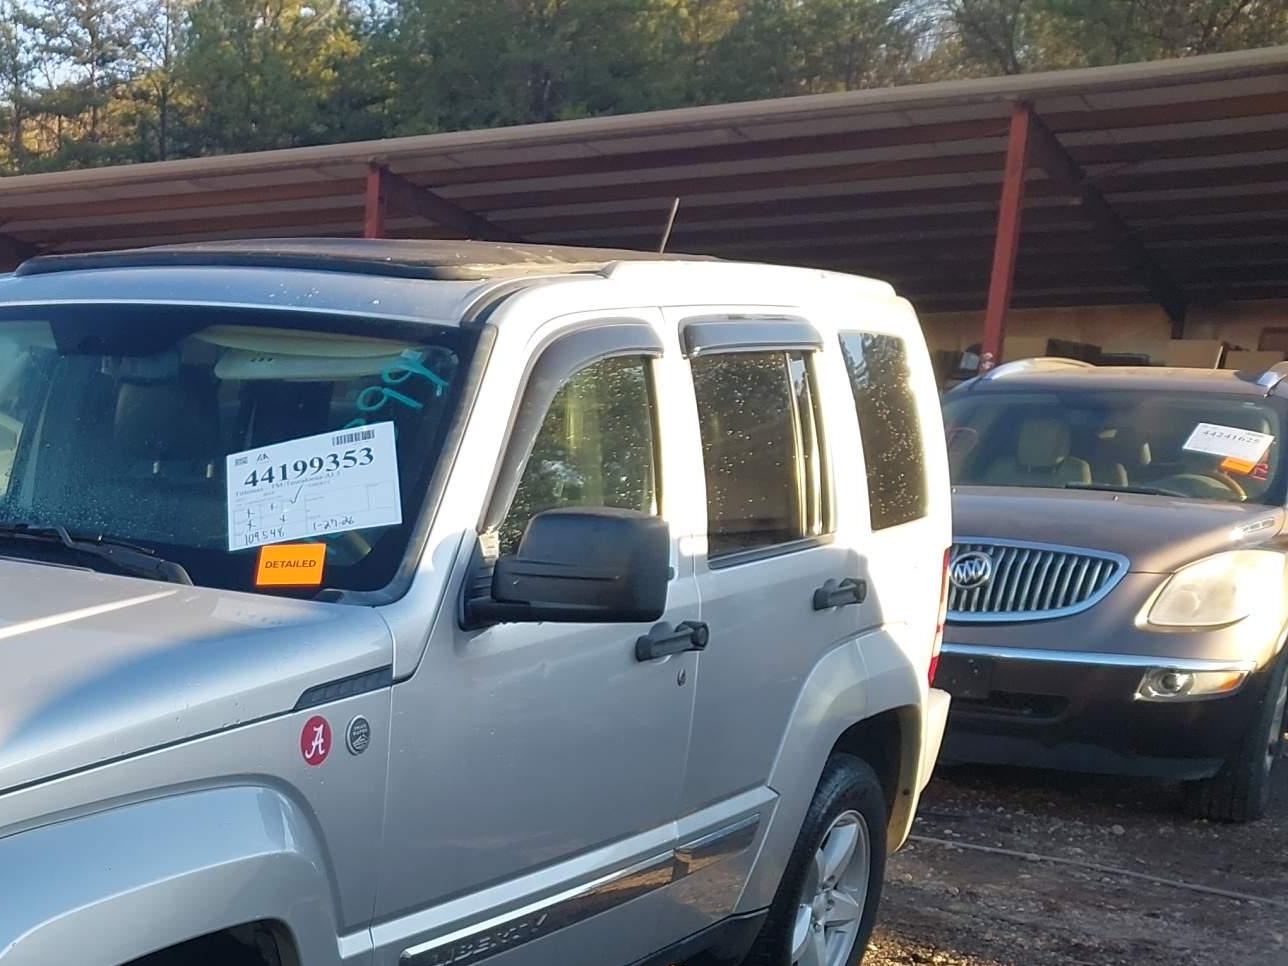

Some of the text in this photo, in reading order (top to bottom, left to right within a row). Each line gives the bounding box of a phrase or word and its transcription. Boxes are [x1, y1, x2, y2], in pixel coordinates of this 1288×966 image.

[244, 447, 375, 488] 44199353
[264, 559, 317, 569] DETAILED
[305, 724, 325, 758] A
